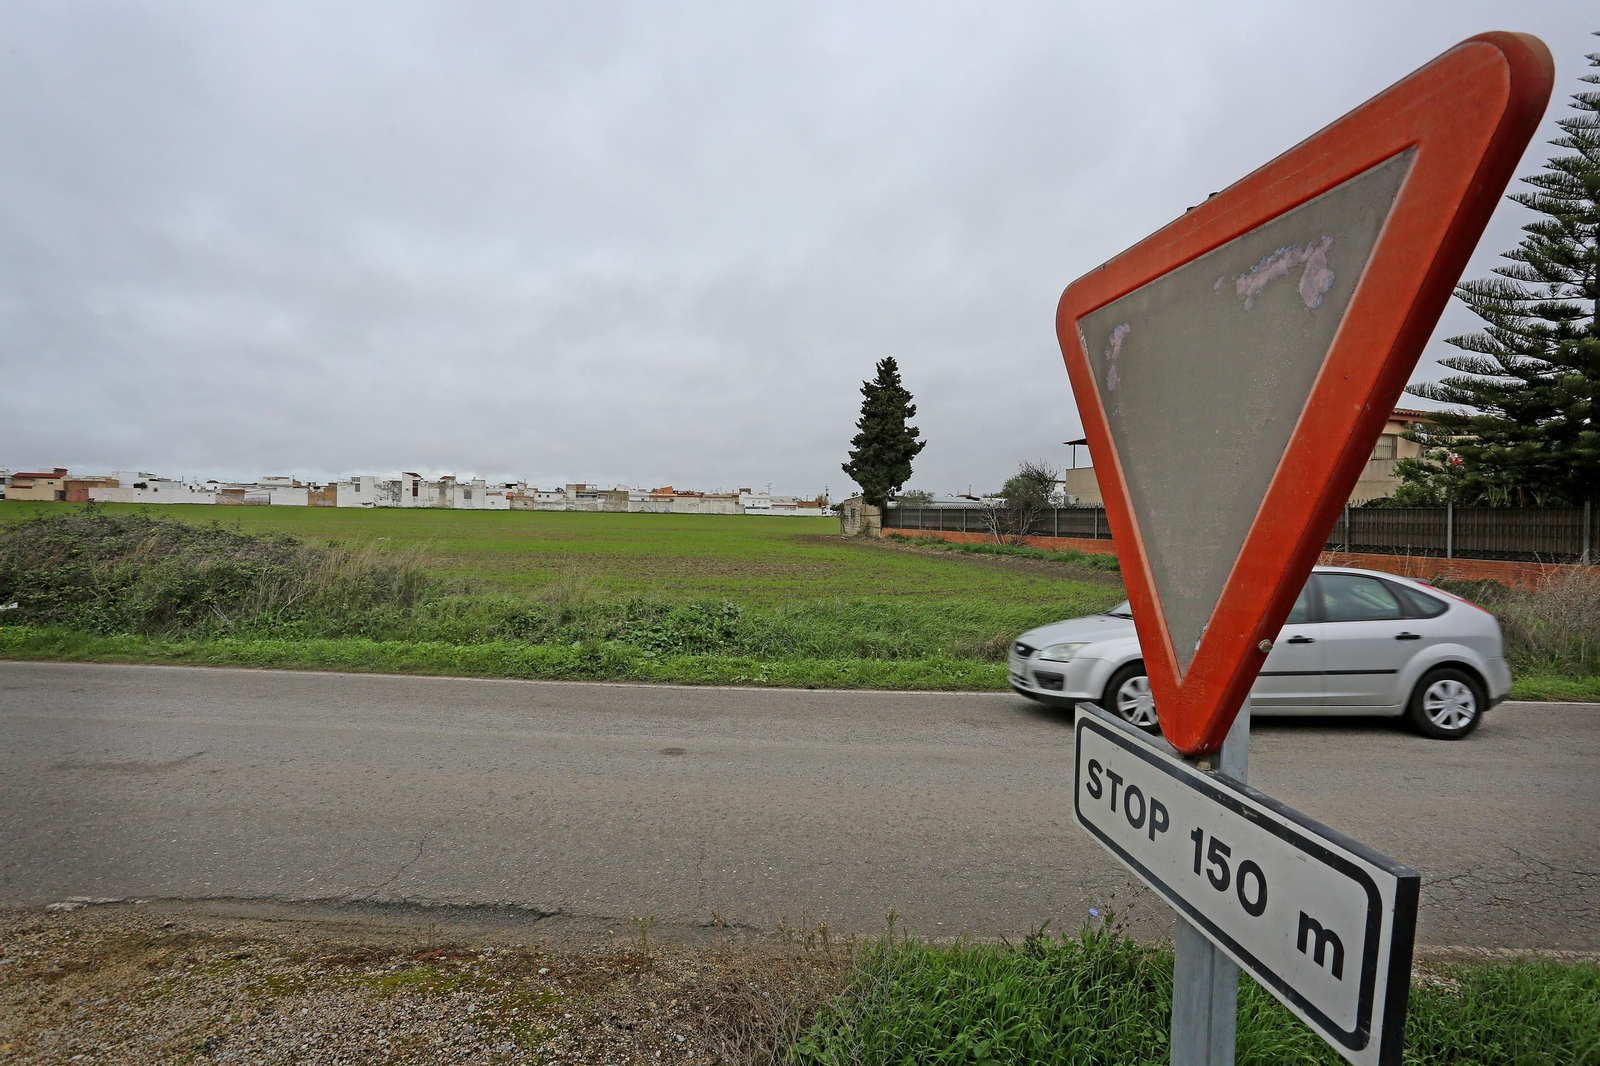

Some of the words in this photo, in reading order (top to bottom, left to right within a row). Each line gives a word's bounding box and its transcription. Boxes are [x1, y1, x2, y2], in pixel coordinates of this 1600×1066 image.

[1086, 758, 1170, 842] STOP
[1190, 826, 1268, 917] 150
[1296, 909, 1345, 982] m
